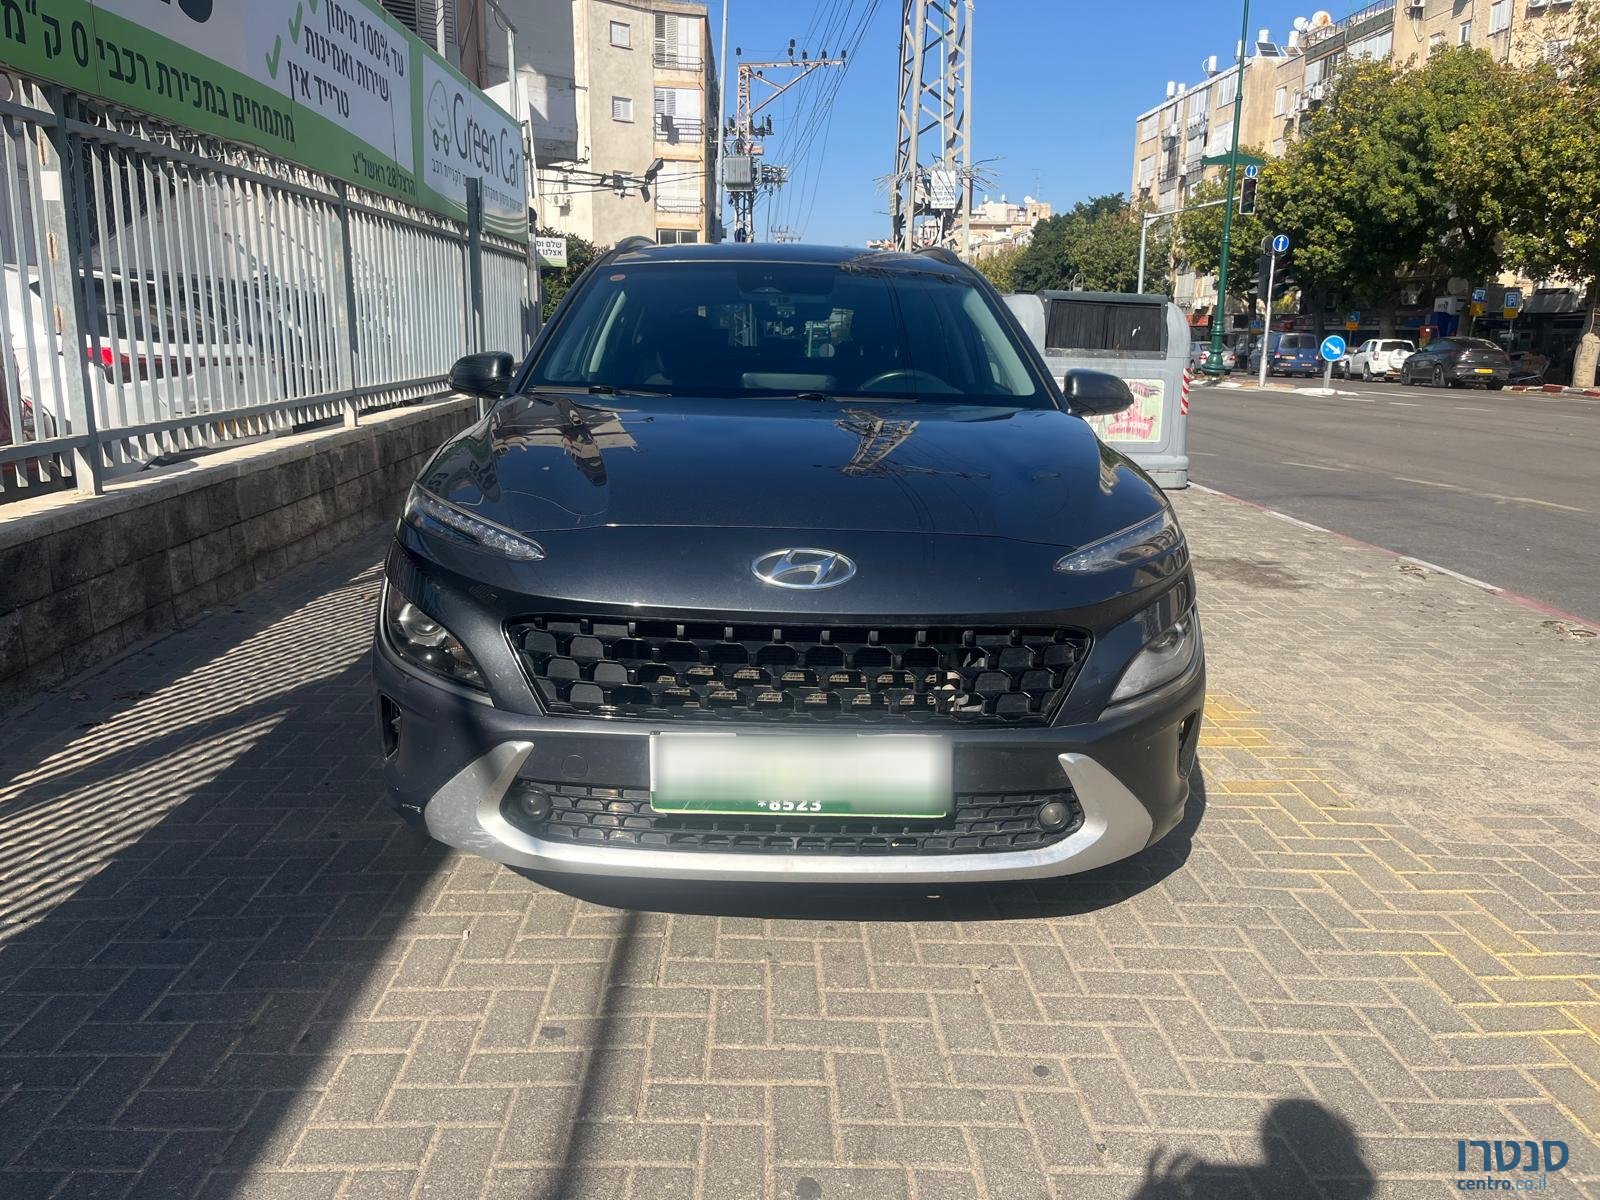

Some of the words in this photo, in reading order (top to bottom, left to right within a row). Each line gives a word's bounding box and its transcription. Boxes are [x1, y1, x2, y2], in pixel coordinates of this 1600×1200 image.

[71, 20, 89, 68] 0
[325, 0, 357, 45] מימון
[360, 20, 389, 68] 100%
[96, 37, 151, 90] רכבי
[304, 25, 354, 82] ואמינות
[390, 47, 404, 77] עד
[156, 60, 229, 119] במכירת
[287, 60, 311, 101] אין
[313, 75, 350, 119] טרייד
[356, 59, 389, 102] שירות
[232, 91, 296, 143] מתמחים
[453, 92, 499, 178] Green
[500, 127, 520, 190] Car
[386, 165, 397, 189] 28
[397, 168, 416, 197] הרצל
[431, 157, 443, 176] רכב
[542, 248, 563, 257] אצלנו
[545, 240, 562, 249] שלם
